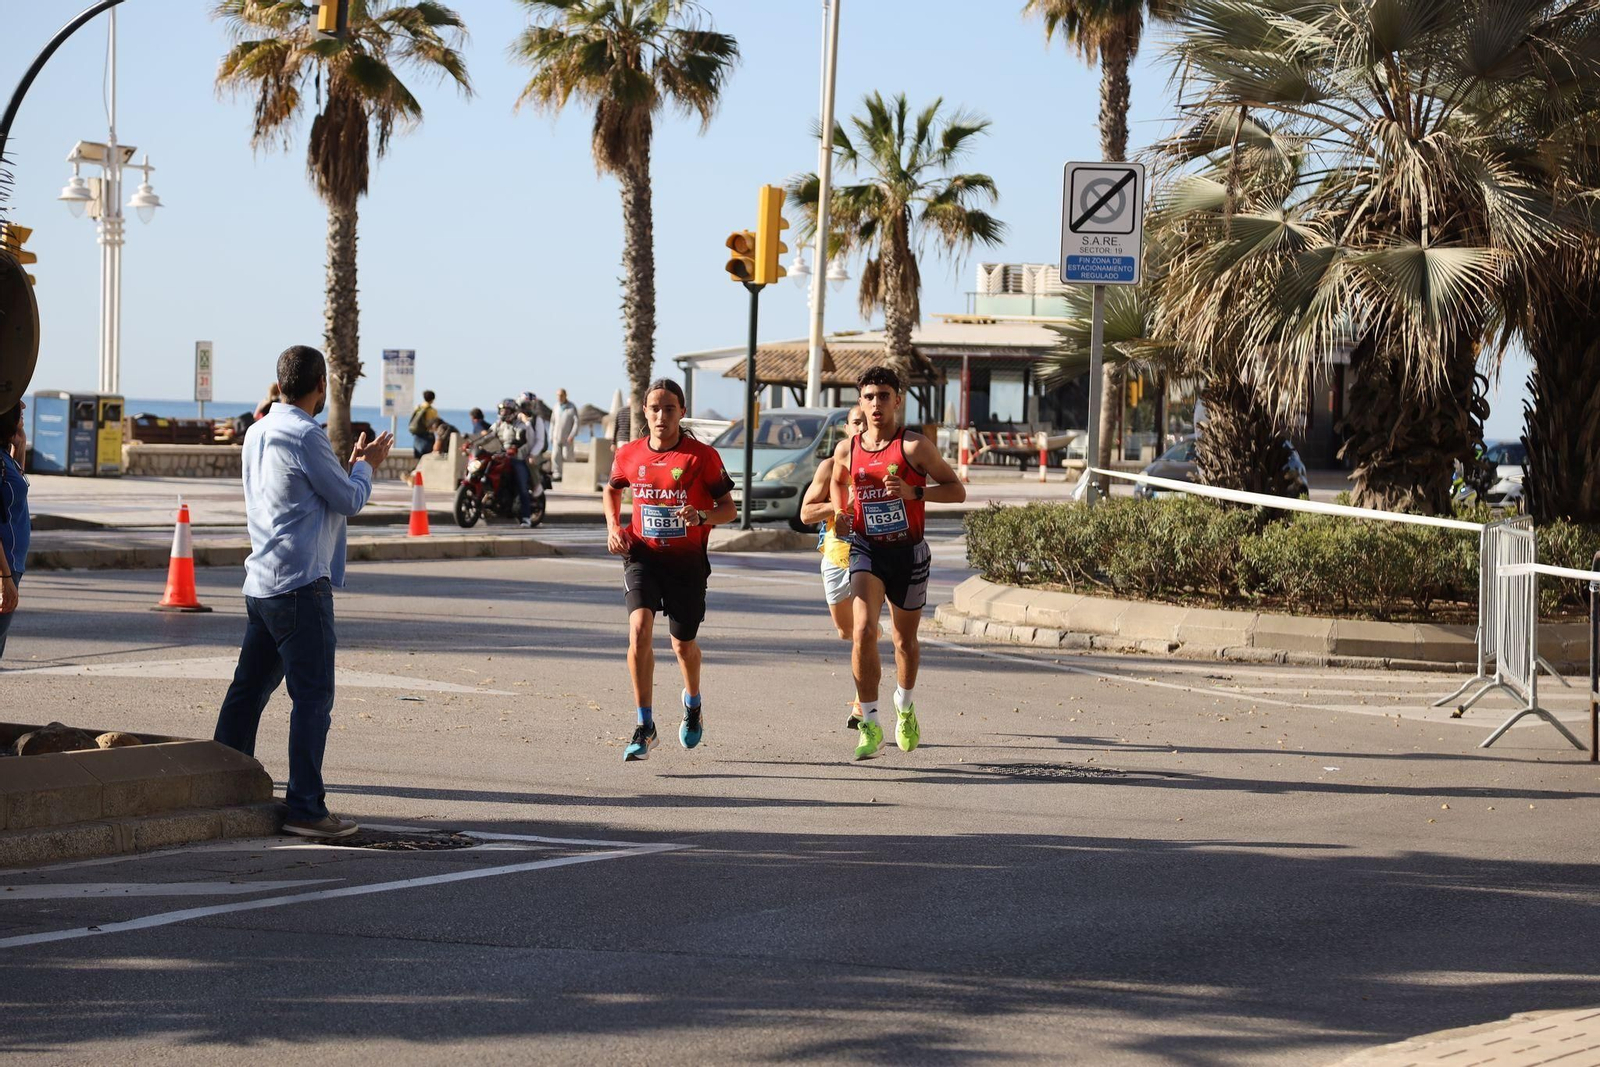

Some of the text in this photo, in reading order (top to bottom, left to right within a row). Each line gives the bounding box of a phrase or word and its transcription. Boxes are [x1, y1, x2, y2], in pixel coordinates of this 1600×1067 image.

[1068, 264, 1133, 272] ESTACIONAMIENTO
[647, 518, 679, 527] 1681
[869, 512, 901, 524] 1634
